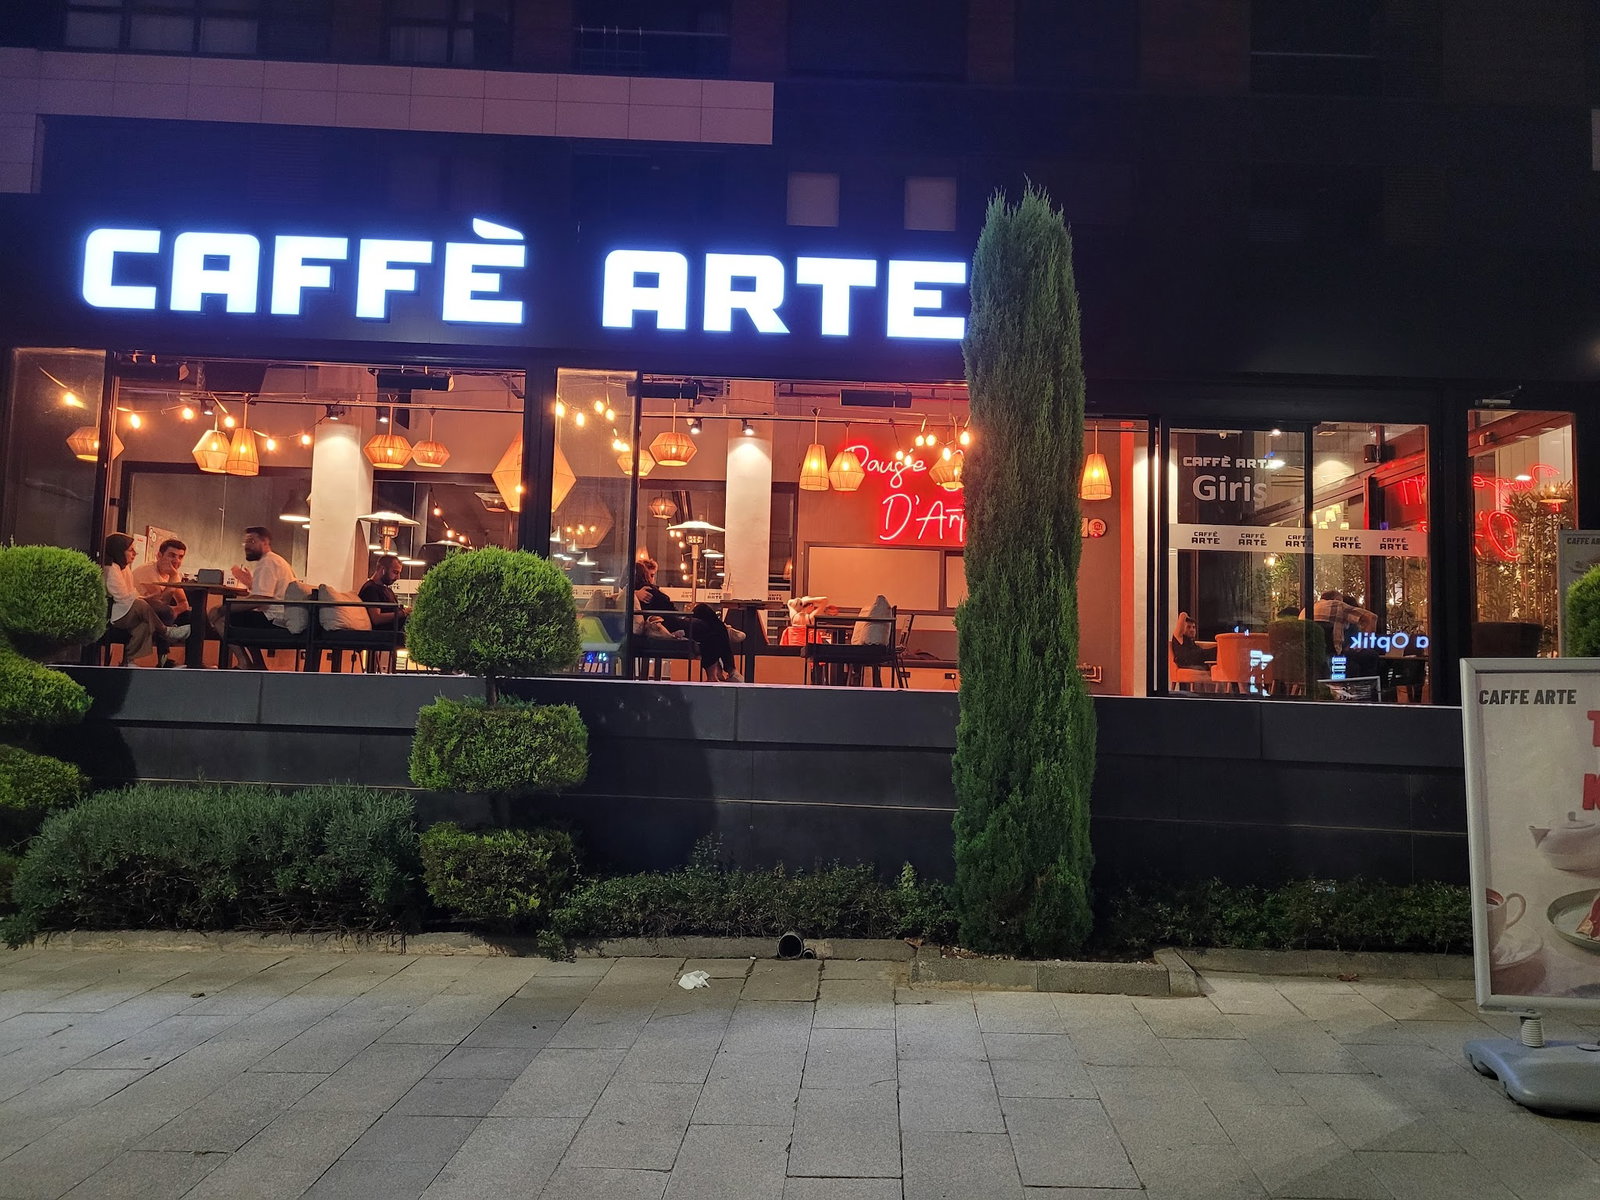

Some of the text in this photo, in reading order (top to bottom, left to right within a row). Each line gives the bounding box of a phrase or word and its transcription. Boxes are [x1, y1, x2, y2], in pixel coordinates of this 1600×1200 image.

[81, 217, 967, 340] CAFFÈ ARTE
[1479, 689, 1577, 705] CAFFE ARTE
